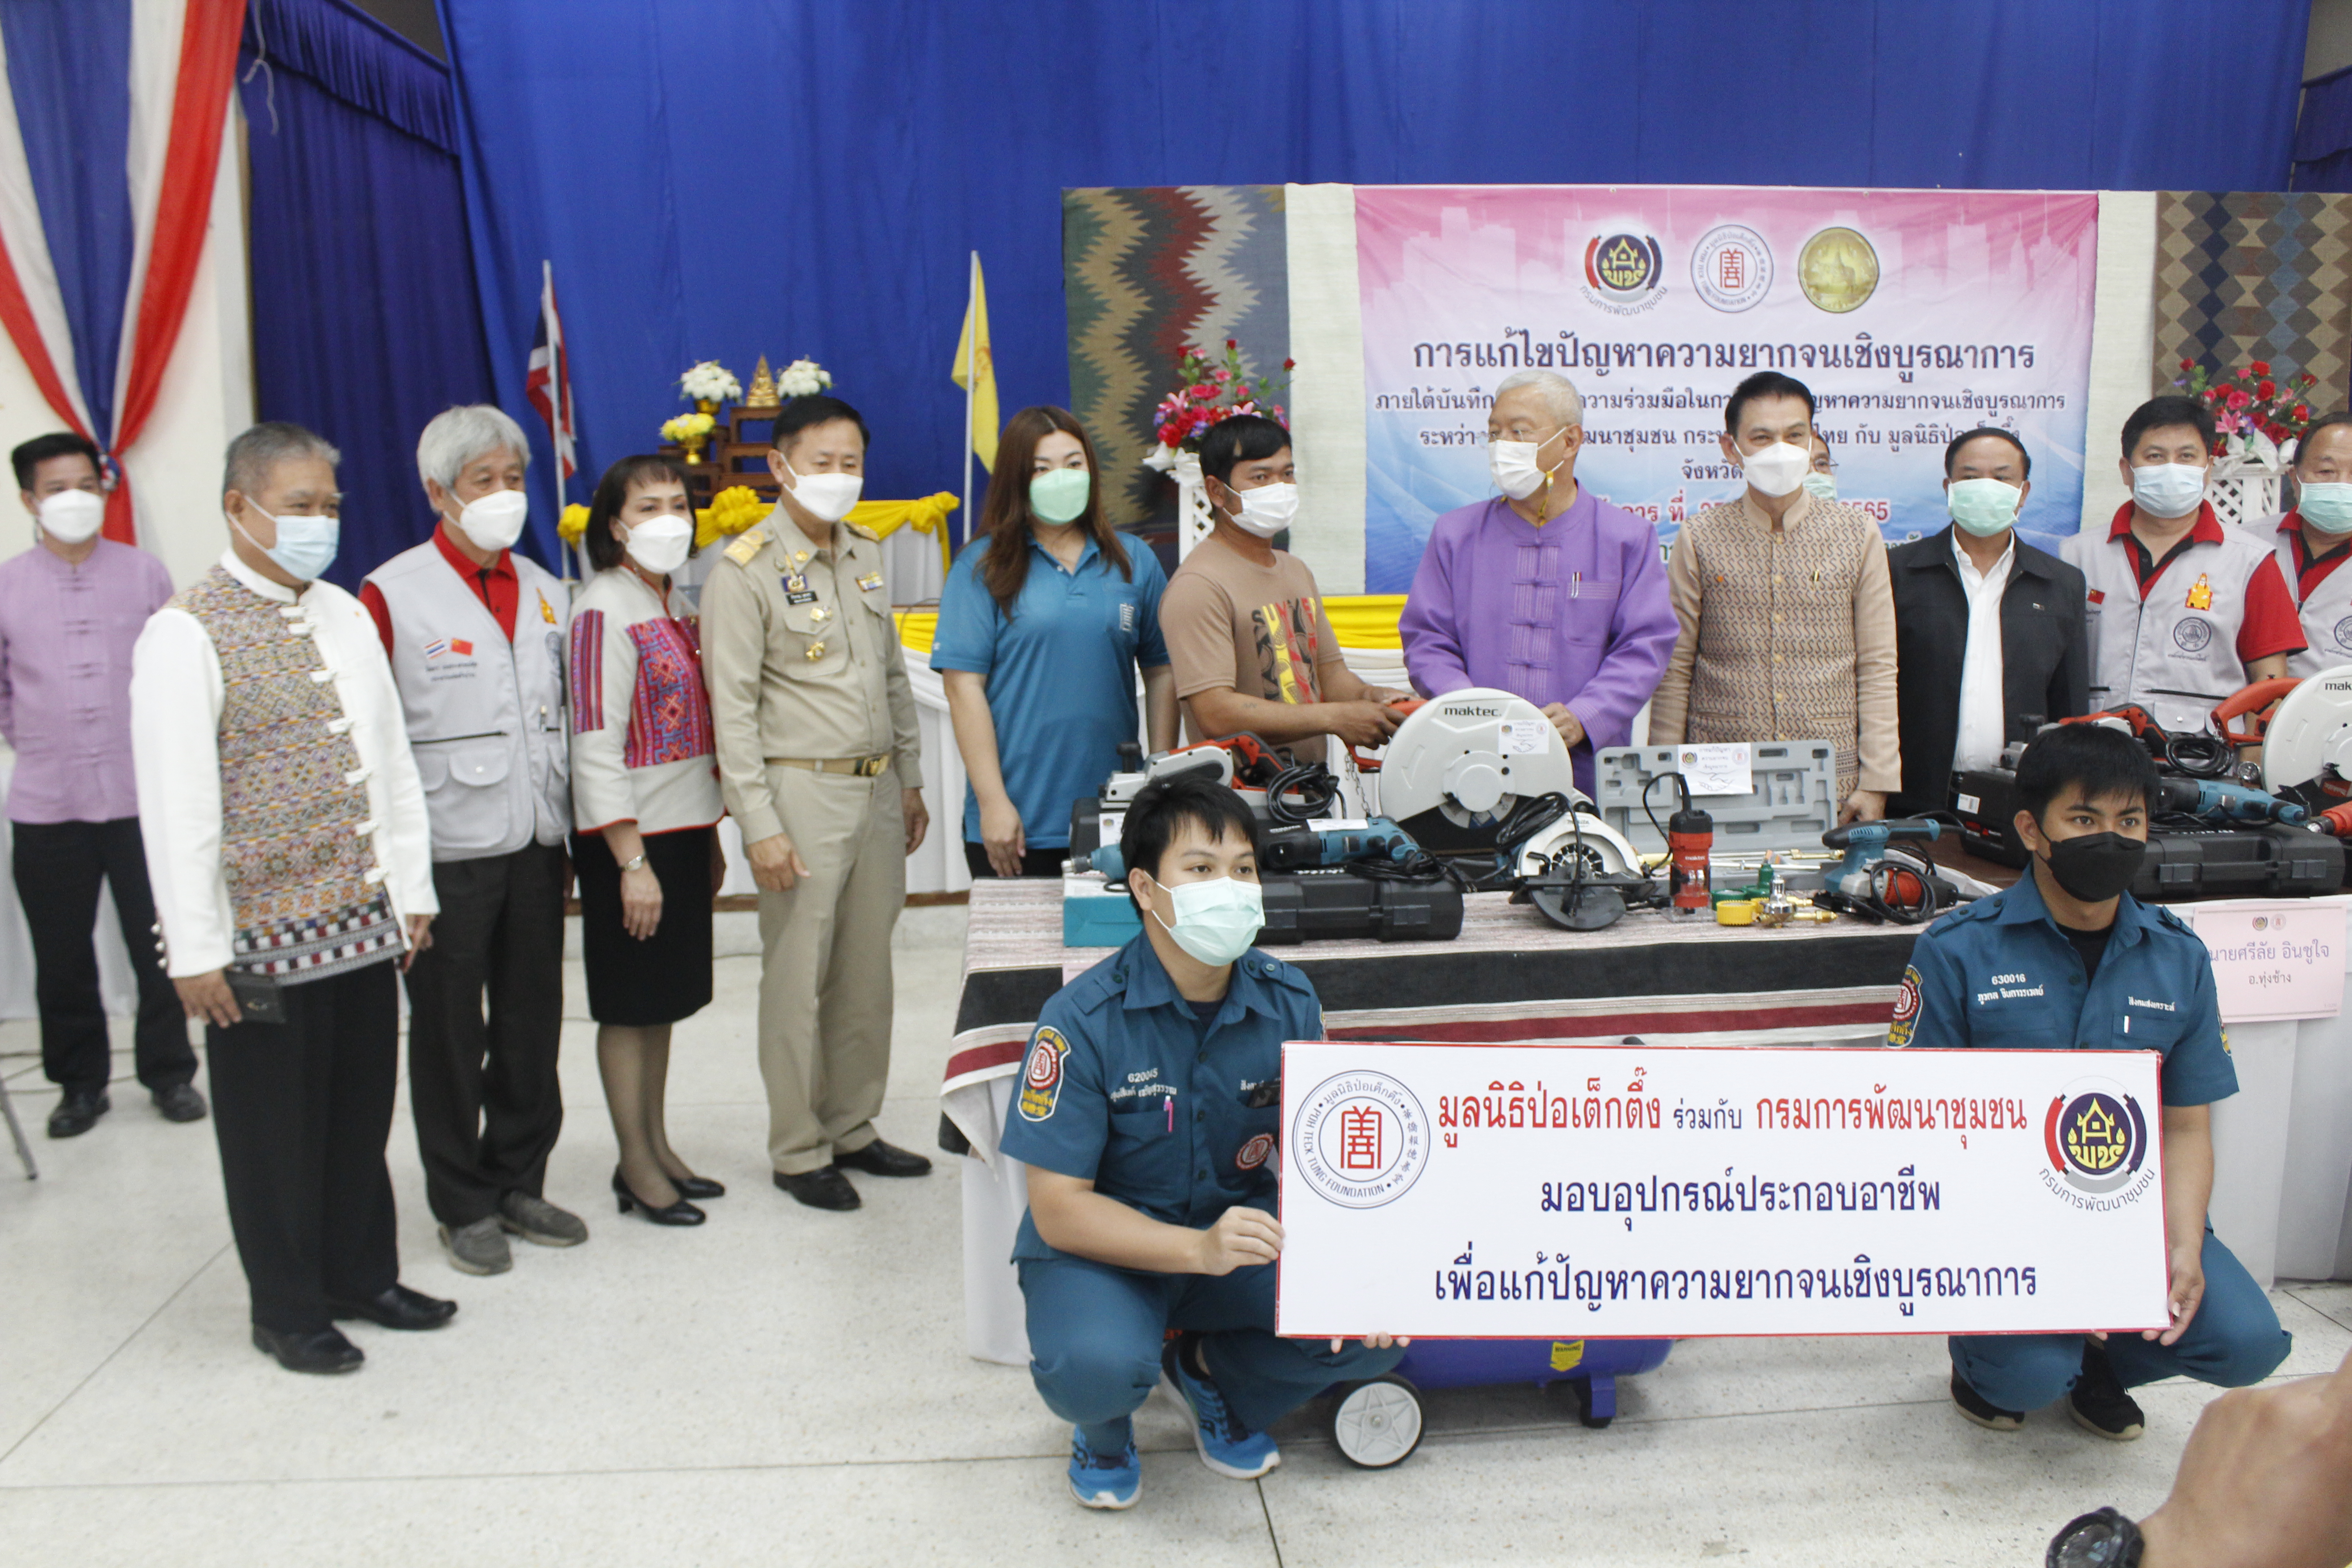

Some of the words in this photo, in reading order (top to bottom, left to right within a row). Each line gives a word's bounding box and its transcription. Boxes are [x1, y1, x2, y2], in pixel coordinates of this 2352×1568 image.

[1413, 327, 2034, 382] การแก้ไขปัญหาความยากจนเชิงบูรณาการ
[1855, 423, 1881, 444] กับ
[1444, 706, 1499, 717] maktec
[2282, 939, 2329, 964] อินชูใจ
[1991, 973, 2026, 985] 630016
[2248, 970, 2291, 988] อ.ทุ่งช้าง
[1439, 1067, 1661, 1148] มูลนิธิป่อเต็กตึ๊ง
[1673, 1098, 1742, 1129] ร่วมกับ
[1756, 1083, 2027, 1150] กรมการพัฒนาชุมชน
[1303, 1131, 1314, 1155] TECK
[1308, 1156, 1328, 1182] TUNG
[1325, 1177, 1385, 1198] FOUNDATION
[1541, 1164, 1940, 1232] มอบอุปกรณ์ประกอบอาชีพ
[2039, 1168, 2155, 1212] กรมการพัฒนาชุมชน
[1436, 1241, 2036, 1317] เพื่อแก้ปัญหาความยากจนเชิงบูรณาการ
